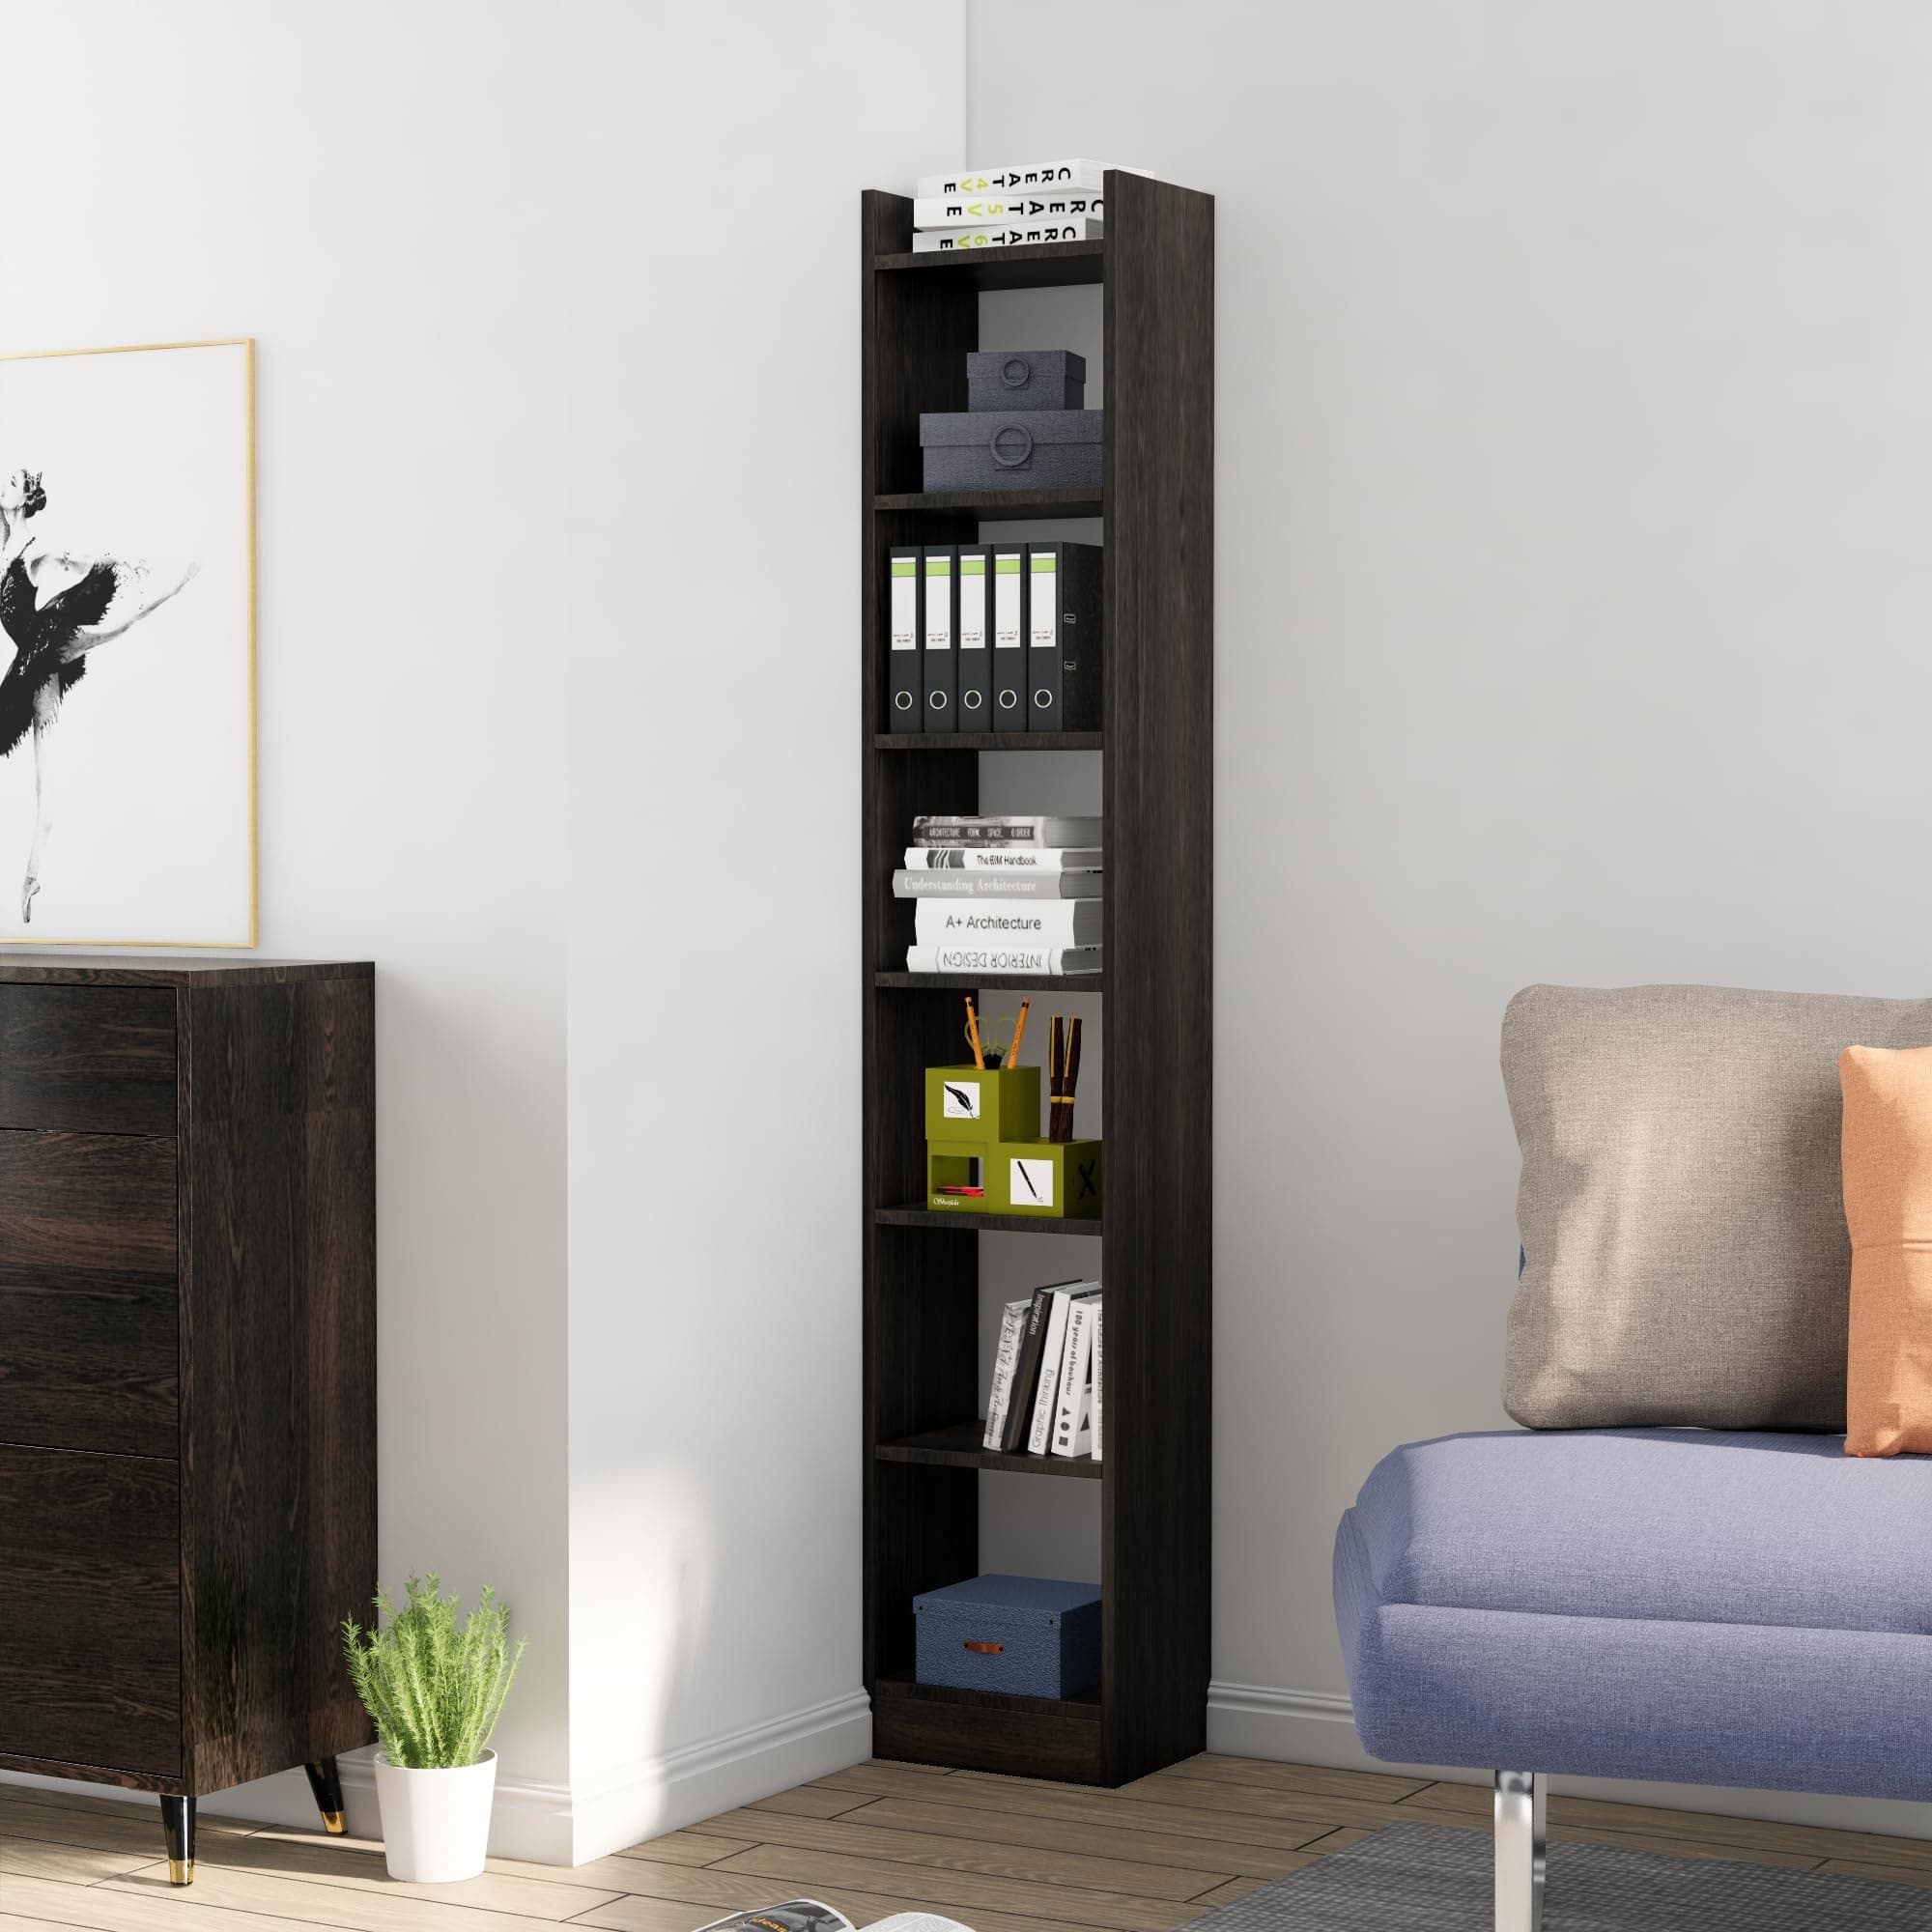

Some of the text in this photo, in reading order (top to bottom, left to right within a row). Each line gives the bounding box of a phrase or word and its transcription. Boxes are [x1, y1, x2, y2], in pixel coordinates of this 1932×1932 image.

[977, 854, 1037, 866] The BIM Handbook
[904, 876, 1037, 895] Understanding Architecture
[946, 915, 1041, 930] A+ Architecture
[943, 952, 1042, 969] INTERIOR DESIGN
[1029, 1294, 1045, 1335] Inspiration
[1070, 1350, 1077, 1360] of
[1065, 1360, 1076, 1396] bauhaus
[1032, 1409, 1046, 1447] Graphic
